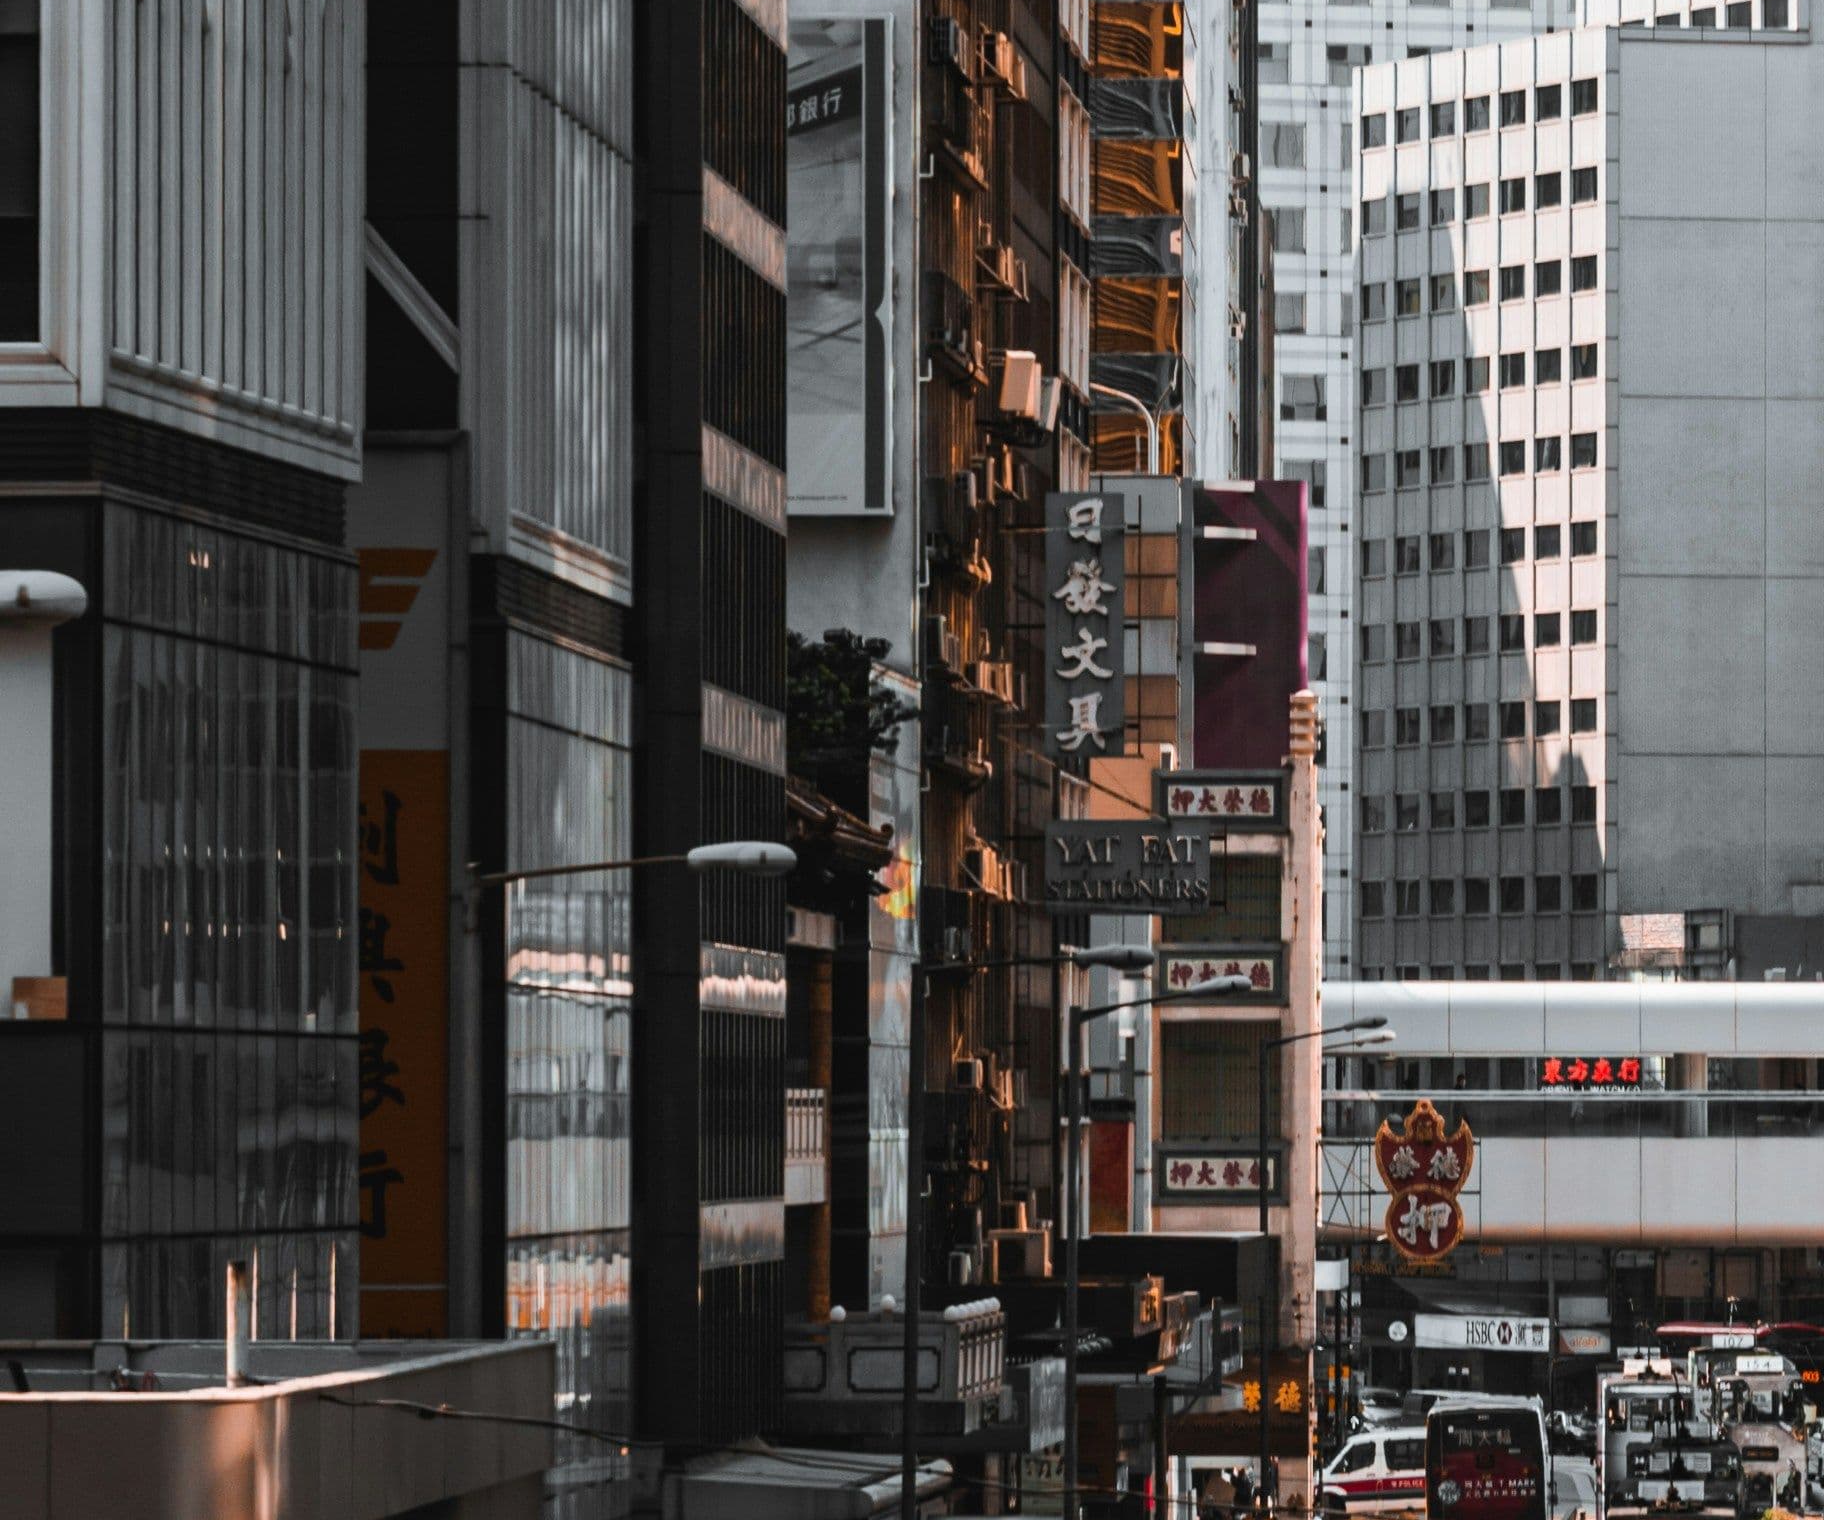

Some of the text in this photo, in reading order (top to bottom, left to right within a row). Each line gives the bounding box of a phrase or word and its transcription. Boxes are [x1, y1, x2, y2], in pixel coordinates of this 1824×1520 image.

[1052, 497, 1118, 751] 日發文具
[1054, 834, 1202, 865] YAT FAT
[1397, 1195, 1453, 1249] 押
[1466, 1320, 1496, 1345] HSBC
